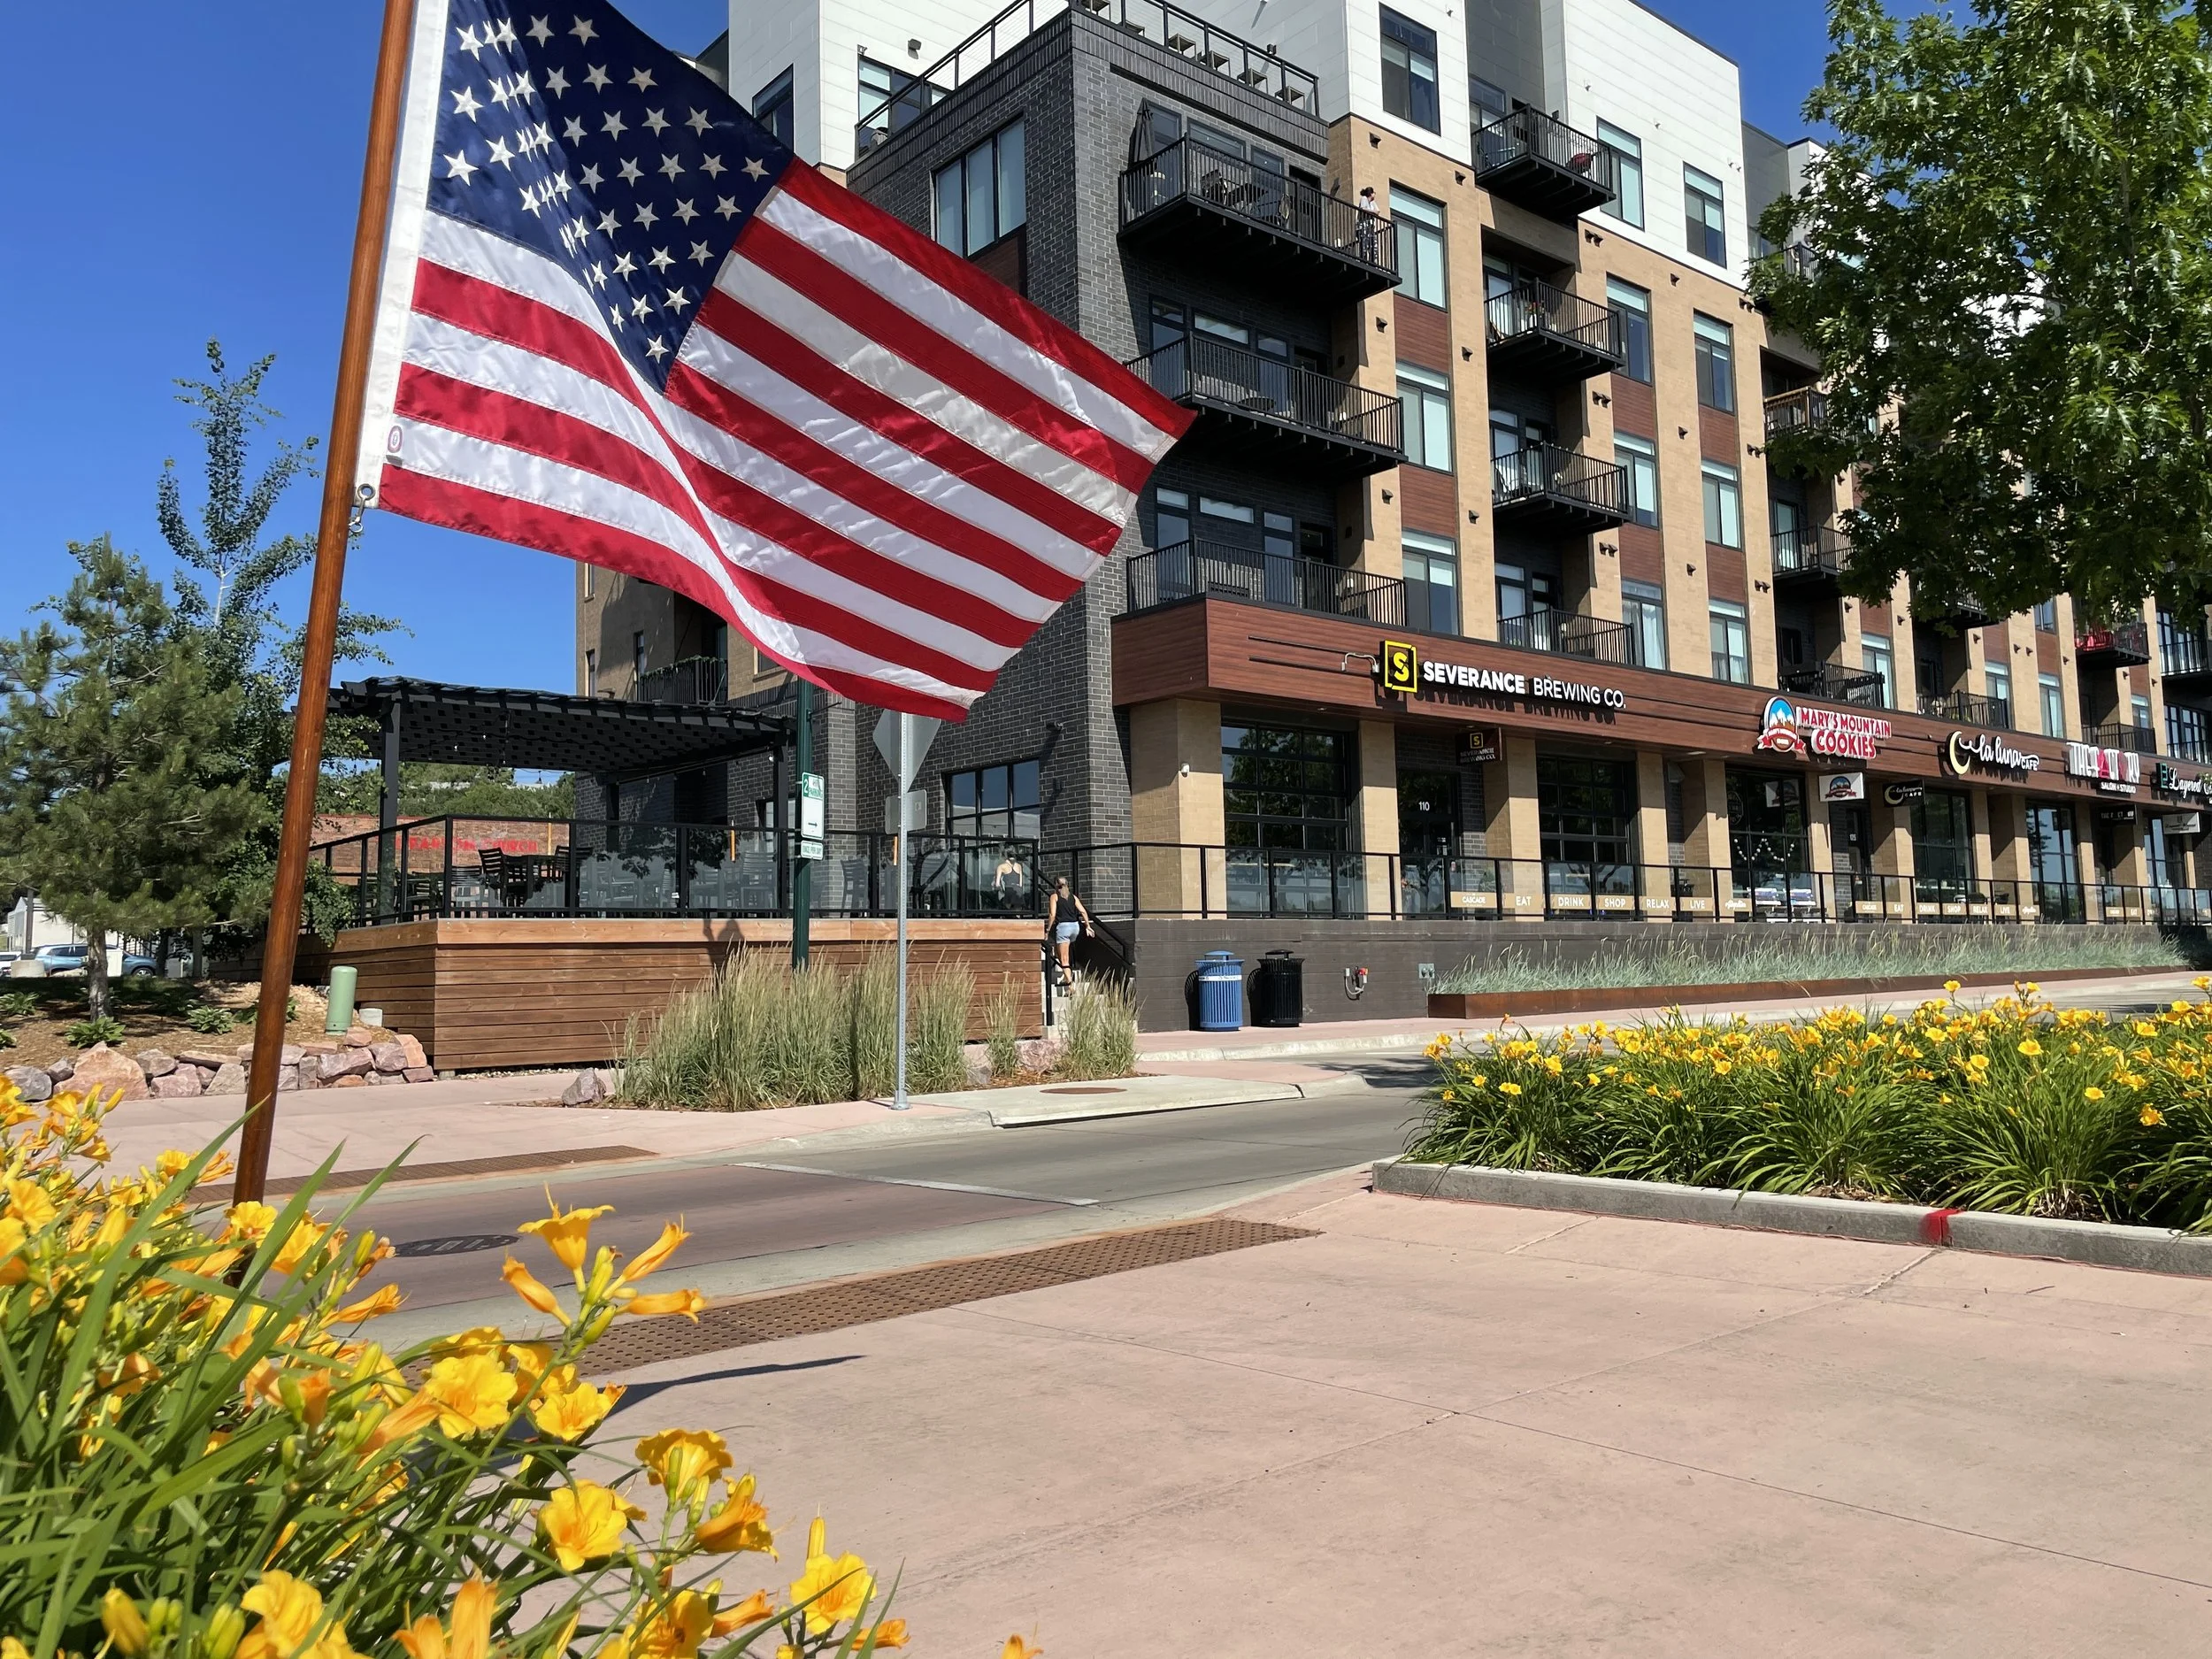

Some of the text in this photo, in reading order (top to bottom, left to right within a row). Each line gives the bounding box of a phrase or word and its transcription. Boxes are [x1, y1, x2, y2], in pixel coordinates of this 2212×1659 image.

[1423, 661, 1525, 694] SEVERANCE
[1533, 677, 1601, 705] BREWING
[1604, 688, 1626, 708] CO.
[1801, 708, 1891, 738] MARY'S MOUNTAIN
[1816, 730, 1876, 758] COOKIES
[803, 778, 809, 794] 2
[2169, 767, 2202, 799] Layered
[1418, 801, 1430, 811] 110
[1462, 895, 1486, 904] CASCADE
[1516, 895, 1532, 906] EAT
[1558, 896, 1585, 907] DRINK
[1604, 897, 1626, 908] SHOP
[1646, 898, 1670, 909] RELAX
[1690, 899, 1705, 910] LIVE
[1893, 903, 1904, 912] EAT
[1972, 905, 1988, 914] RELAX
